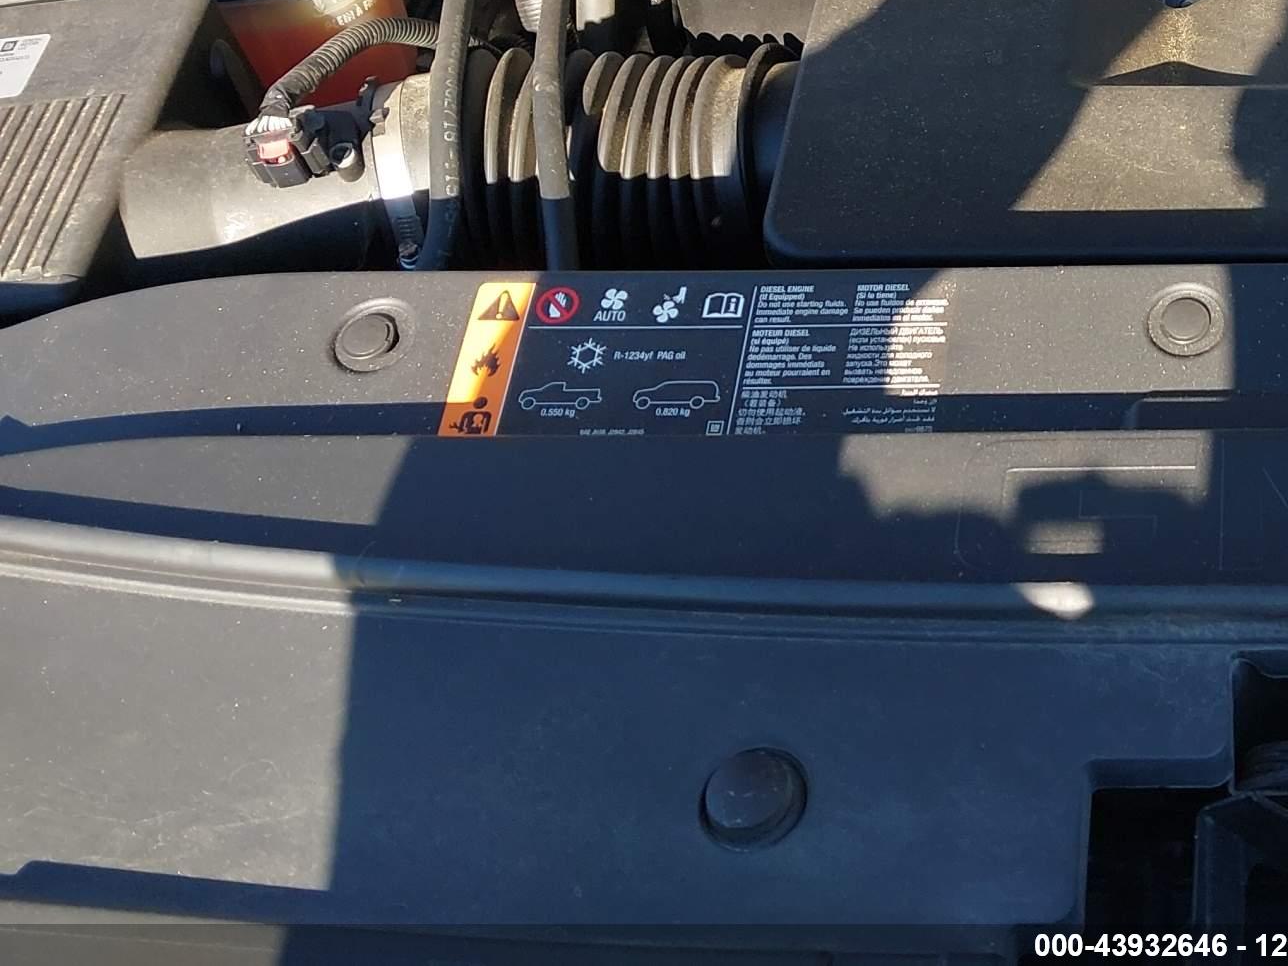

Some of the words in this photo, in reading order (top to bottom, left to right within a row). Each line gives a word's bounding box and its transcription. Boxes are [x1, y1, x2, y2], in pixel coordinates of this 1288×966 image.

[760, 285, 786, 293] DIESEL
[786, 285, 815, 293] ENGINE
[857, 284, 884, 292] MOTOR
[768, 293, 806, 301] Equipped)
[796, 301, 824, 309] starting
[594, 310, 627, 323] AUTO
[820, 309, 849, 317] damage
[752, 329, 783, 337] MOTEUR
[784, 329, 810, 337] DIESEL
[760, 346, 774, 354] pas
[614, 351, 654, 362] R-1234yf
[656, 351, 674, 360] PAG
[675, 350, 686, 360] oil
[746, 361, 786, 370] dommages
[782, 369, 820, 378] pourraient
[540, 408, 563, 418] 0.550
[564, 408, 576, 419] kg
[656, 408, 678, 418] 0.820
[680, 408, 691, 419] kg
